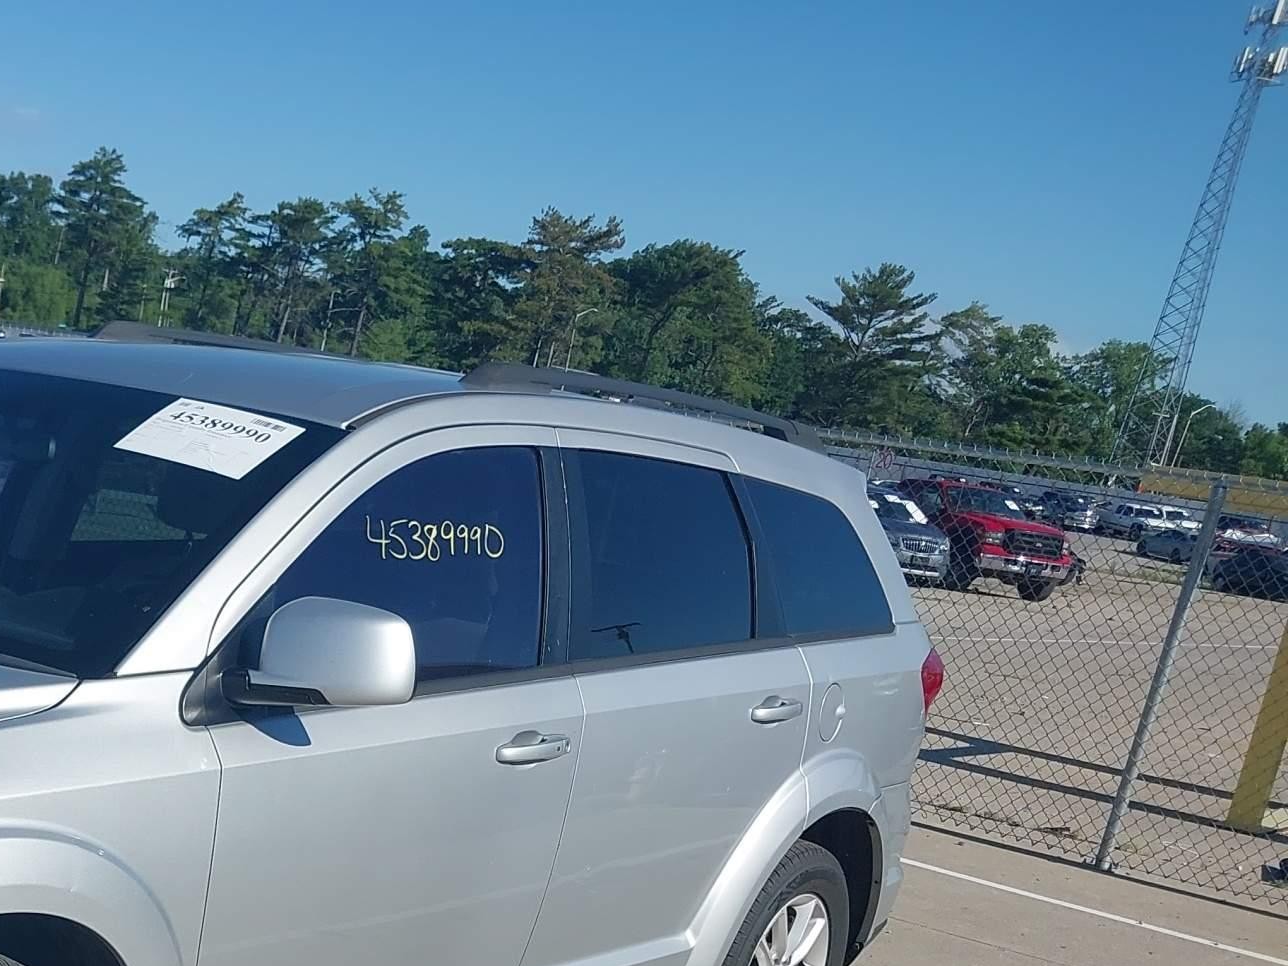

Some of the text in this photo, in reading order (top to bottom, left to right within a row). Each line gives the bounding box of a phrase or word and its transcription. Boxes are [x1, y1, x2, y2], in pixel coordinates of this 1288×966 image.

[169, 410, 272, 444] 45389990
[875, 452, 893, 469] 20
[366, 515, 505, 561] 45389990
